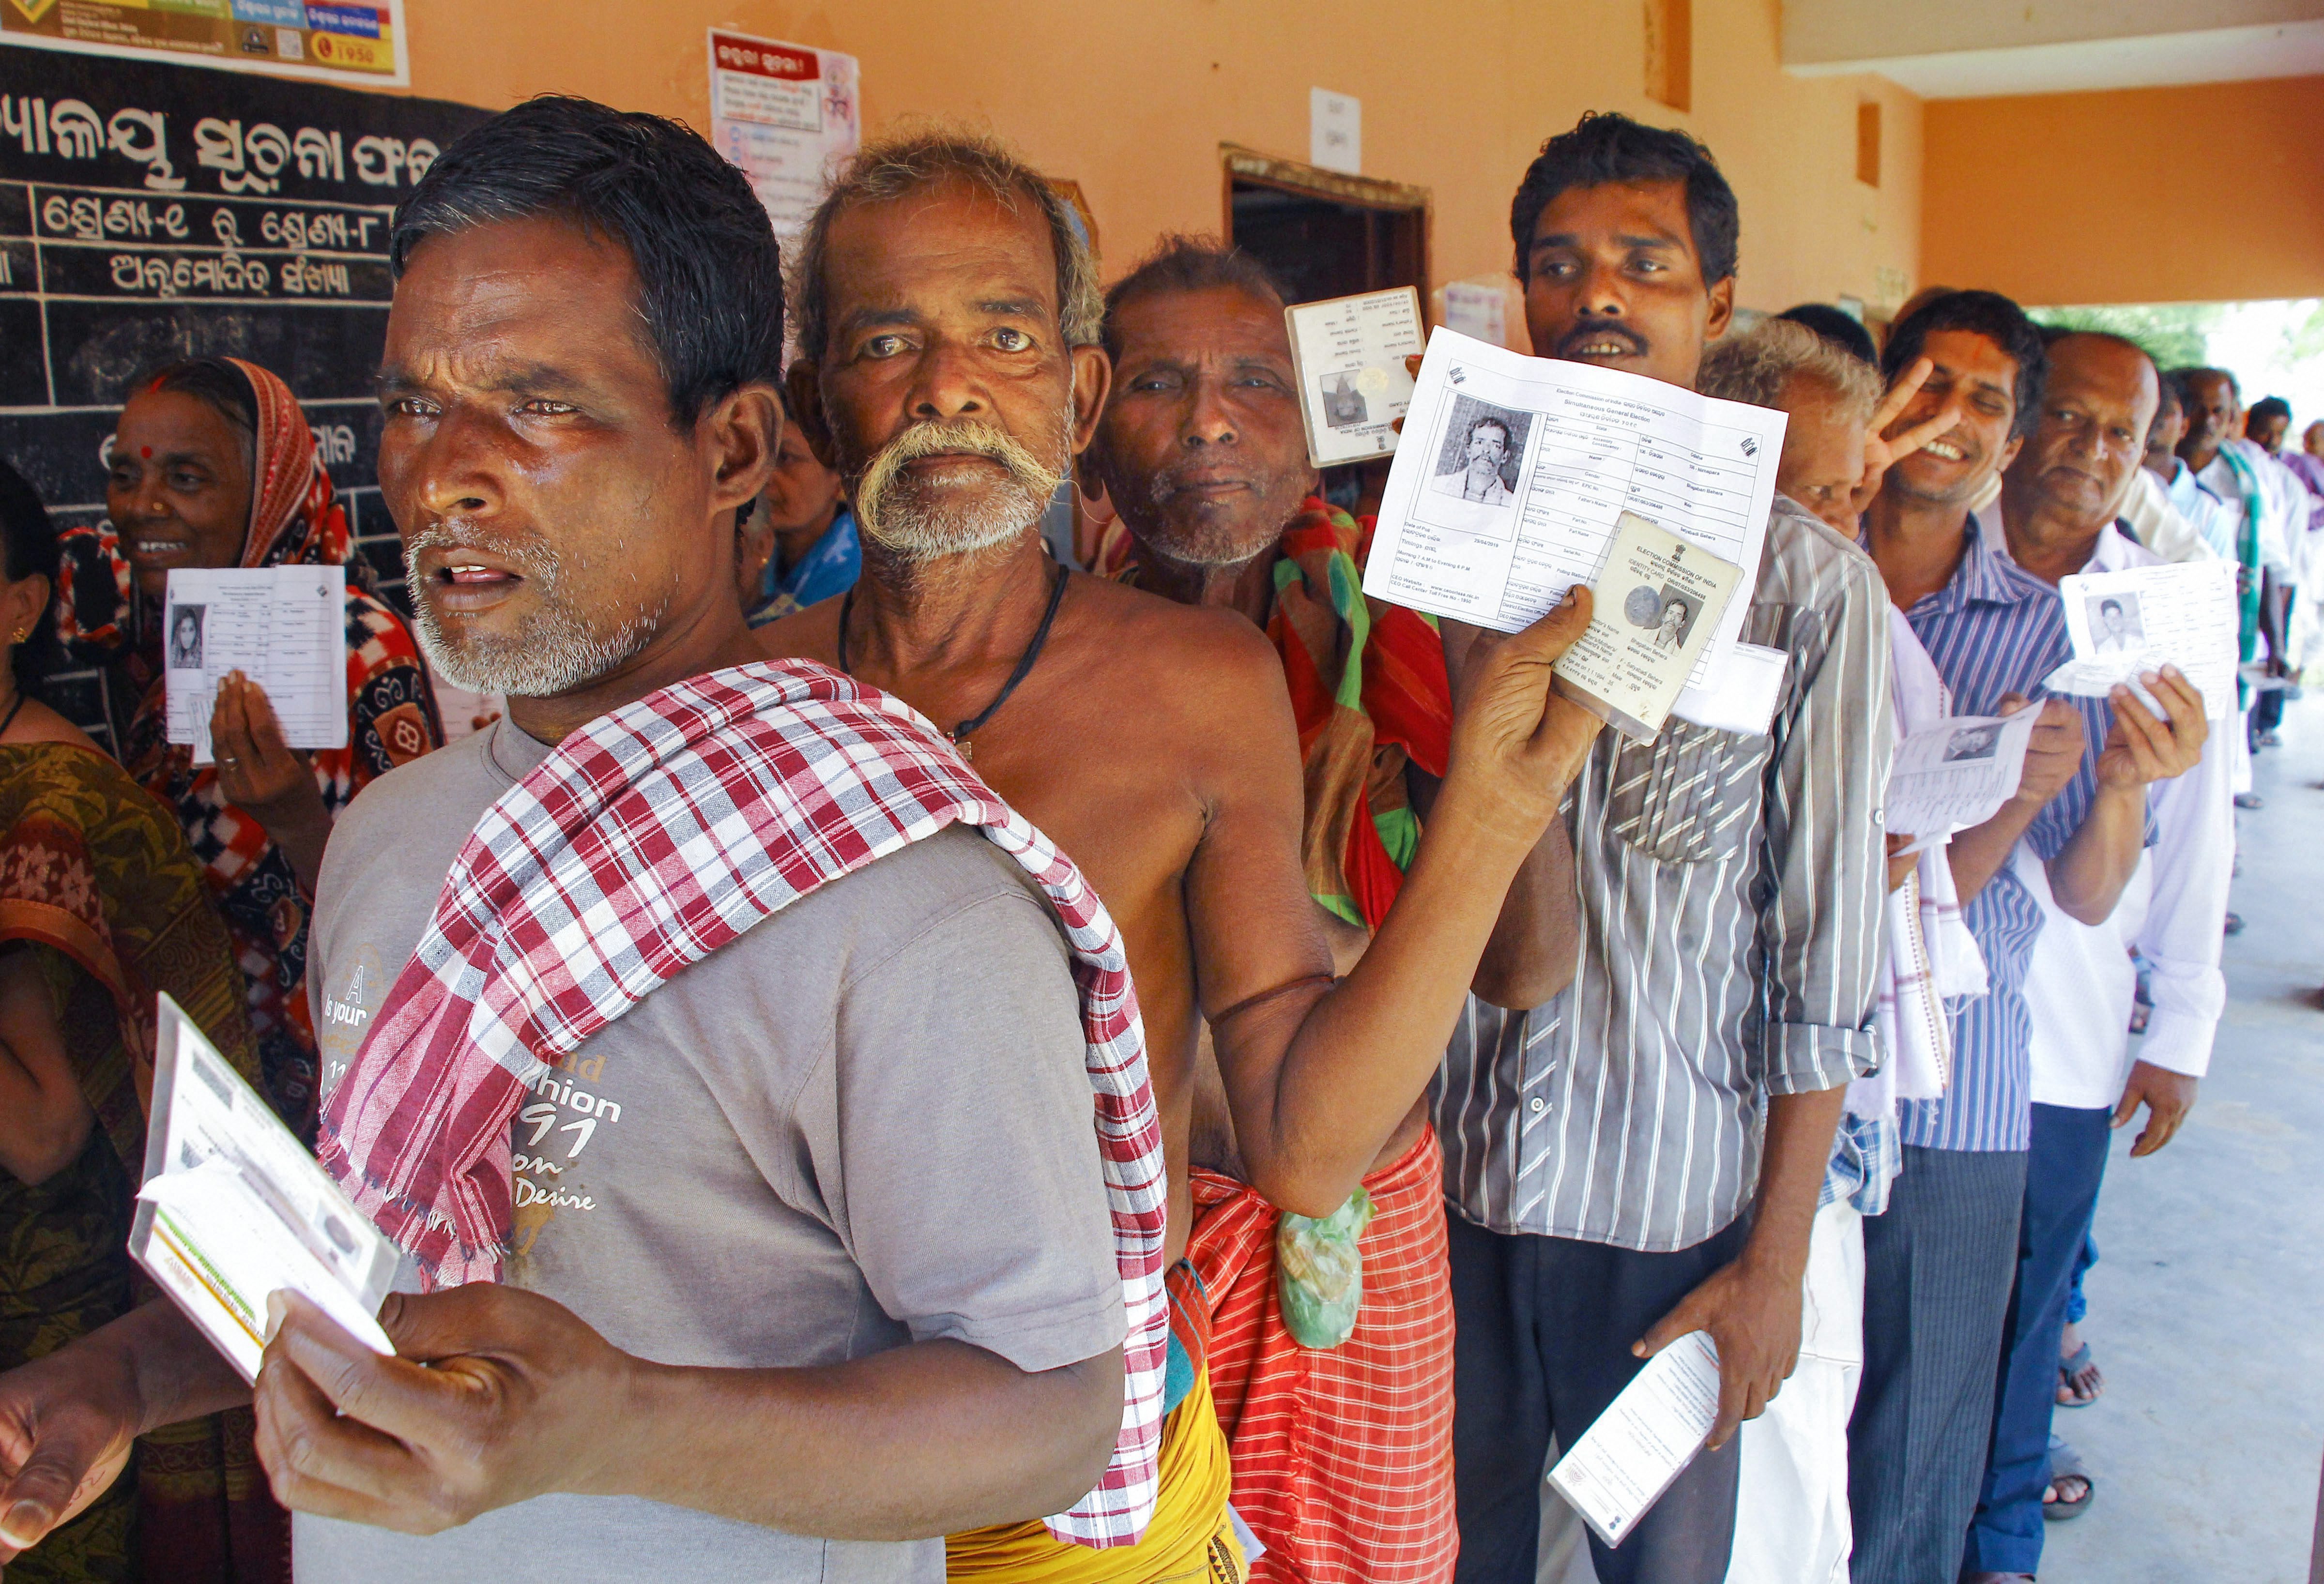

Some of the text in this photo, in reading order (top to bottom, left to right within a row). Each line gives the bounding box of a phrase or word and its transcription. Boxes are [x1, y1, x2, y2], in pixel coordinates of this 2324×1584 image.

[337, 46, 375, 64] 1950
[1575, 392, 1604, 401] Commission
[1564, 399, 1650, 423] Simultaneous General Election
[1697, 467, 1720, 475] Nimapara
[1402, 538, 1422, 548] Timings
[1700, 533, 1715, 541] Behera
[1397, 549, 1417, 559] Morning
[1437, 560, 1456, 569] Evening
[1628, 558, 1651, 572] IDENTITY
[1650, 569, 1665, 579] CARD
[1636, 546, 1662, 561] ELECTION
[1662, 558, 1695, 578] COMMISSION
[1702, 578, 1716, 589] INDIA
[1404, 578, 1422, 586] Website
[1590, 616, 1606, 628] ector's
[1606, 625, 1620, 635] Name
[1600, 646, 1612, 656] Name
[1631, 637, 1667, 660] Bhagaban Behera
[1611, 672, 1622, 681] Male
[1626, 662, 1648, 676] Satyabadi
[1647, 673, 1663, 685] Behera
[346, 965, 363, 1004] A
[332, 1001, 367, 1026] your
[532, 1070, 622, 1123] hion
[512, 1153, 563, 1174] on
[516, 1177, 596, 1210] Desire
